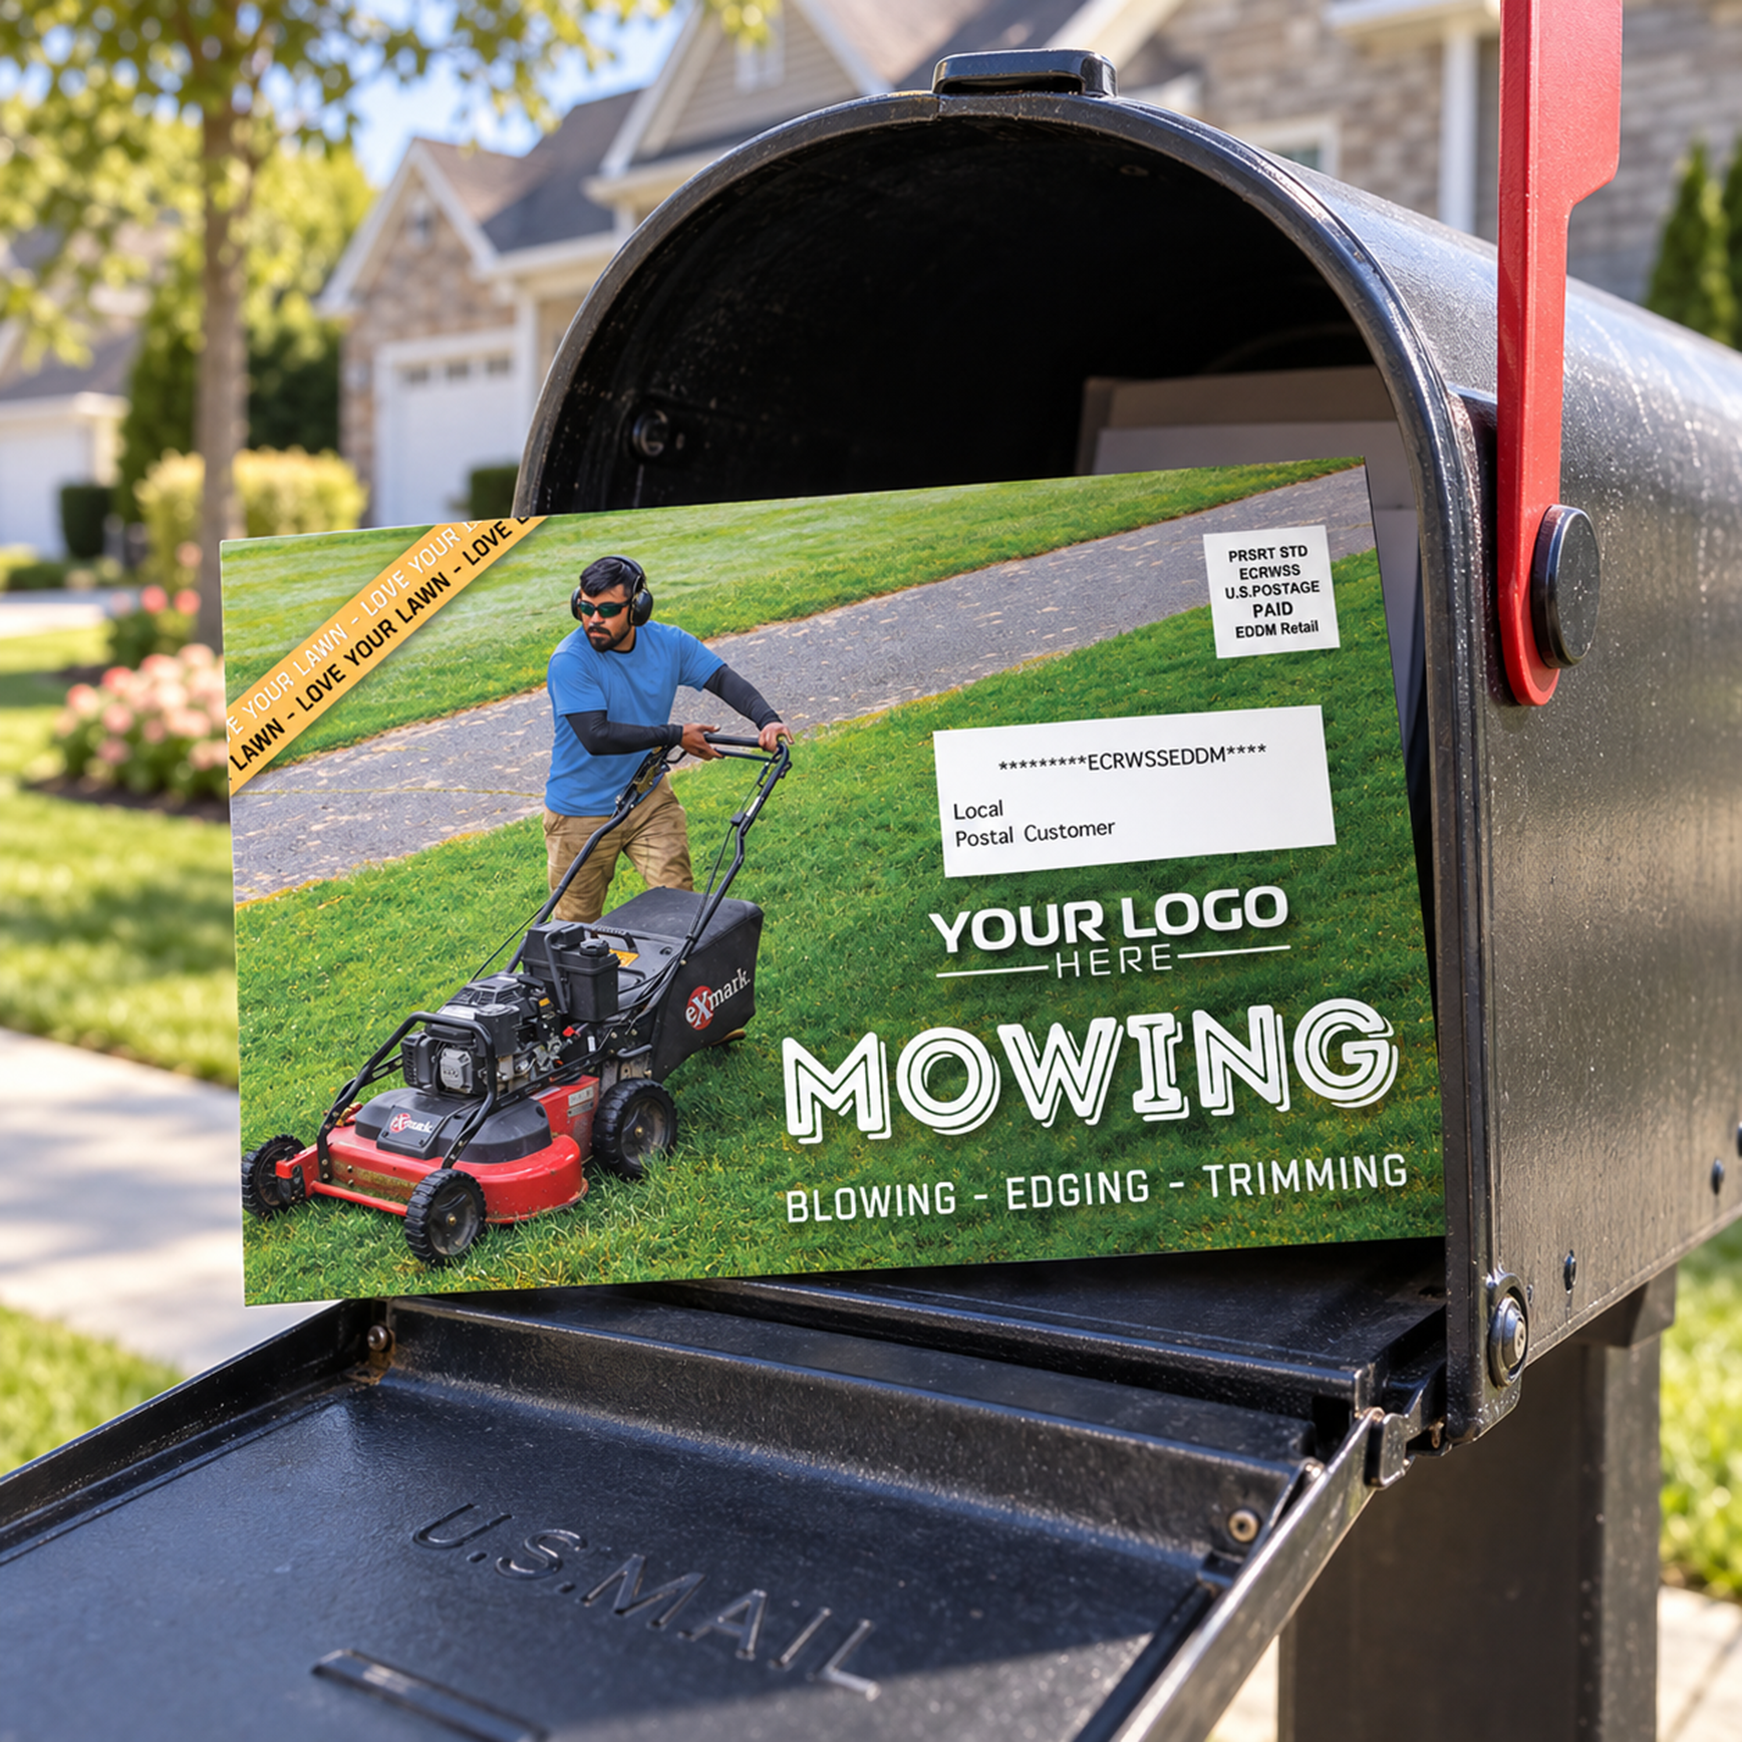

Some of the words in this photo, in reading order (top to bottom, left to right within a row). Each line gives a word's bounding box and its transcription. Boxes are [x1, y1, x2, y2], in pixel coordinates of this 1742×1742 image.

[1228, 547, 1276, 562] PRSRT
[1280, 545, 1308, 558] STD
[1239, 564, 1301, 580] ECRWSS
[1225, 580, 1320, 599] U.S.POSTAGE
[241, 671, 294, 720] YOUR
[293, 623, 348, 676] LAWN
[360, 570, 410, 617] LOVE
[408, 527, 461, 575] YOUR
[1253, 602, 1293, 618] PAID
[1235, 623, 1277, 638] EDDM
[1281, 620, 1319, 635] Retail
[229, 718, 285, 771] LAWN
[295, 664, 346, 712] LOVE
[344, 618, 398, 668] YOUR
[395, 571, 451, 624] LAWN
[462, 520, 513, 566] LOVE
[953, 799, 1004, 820] Local
[955, 826, 1014, 847] Postal
[1024, 820, 1116, 842] Customer
[929, 901, 1106, 953] YOUR
[1121, 886, 1289, 939] LOGO
[1056, 943, 1173, 979] HERE
[782, 998, 1399, 1144] MOWING
[787, 1181, 956, 1223] BLOWING
[1007, 1168, 1150, 1210] EDGING
[1203, 1153, 1407, 1198] TRIMMING
